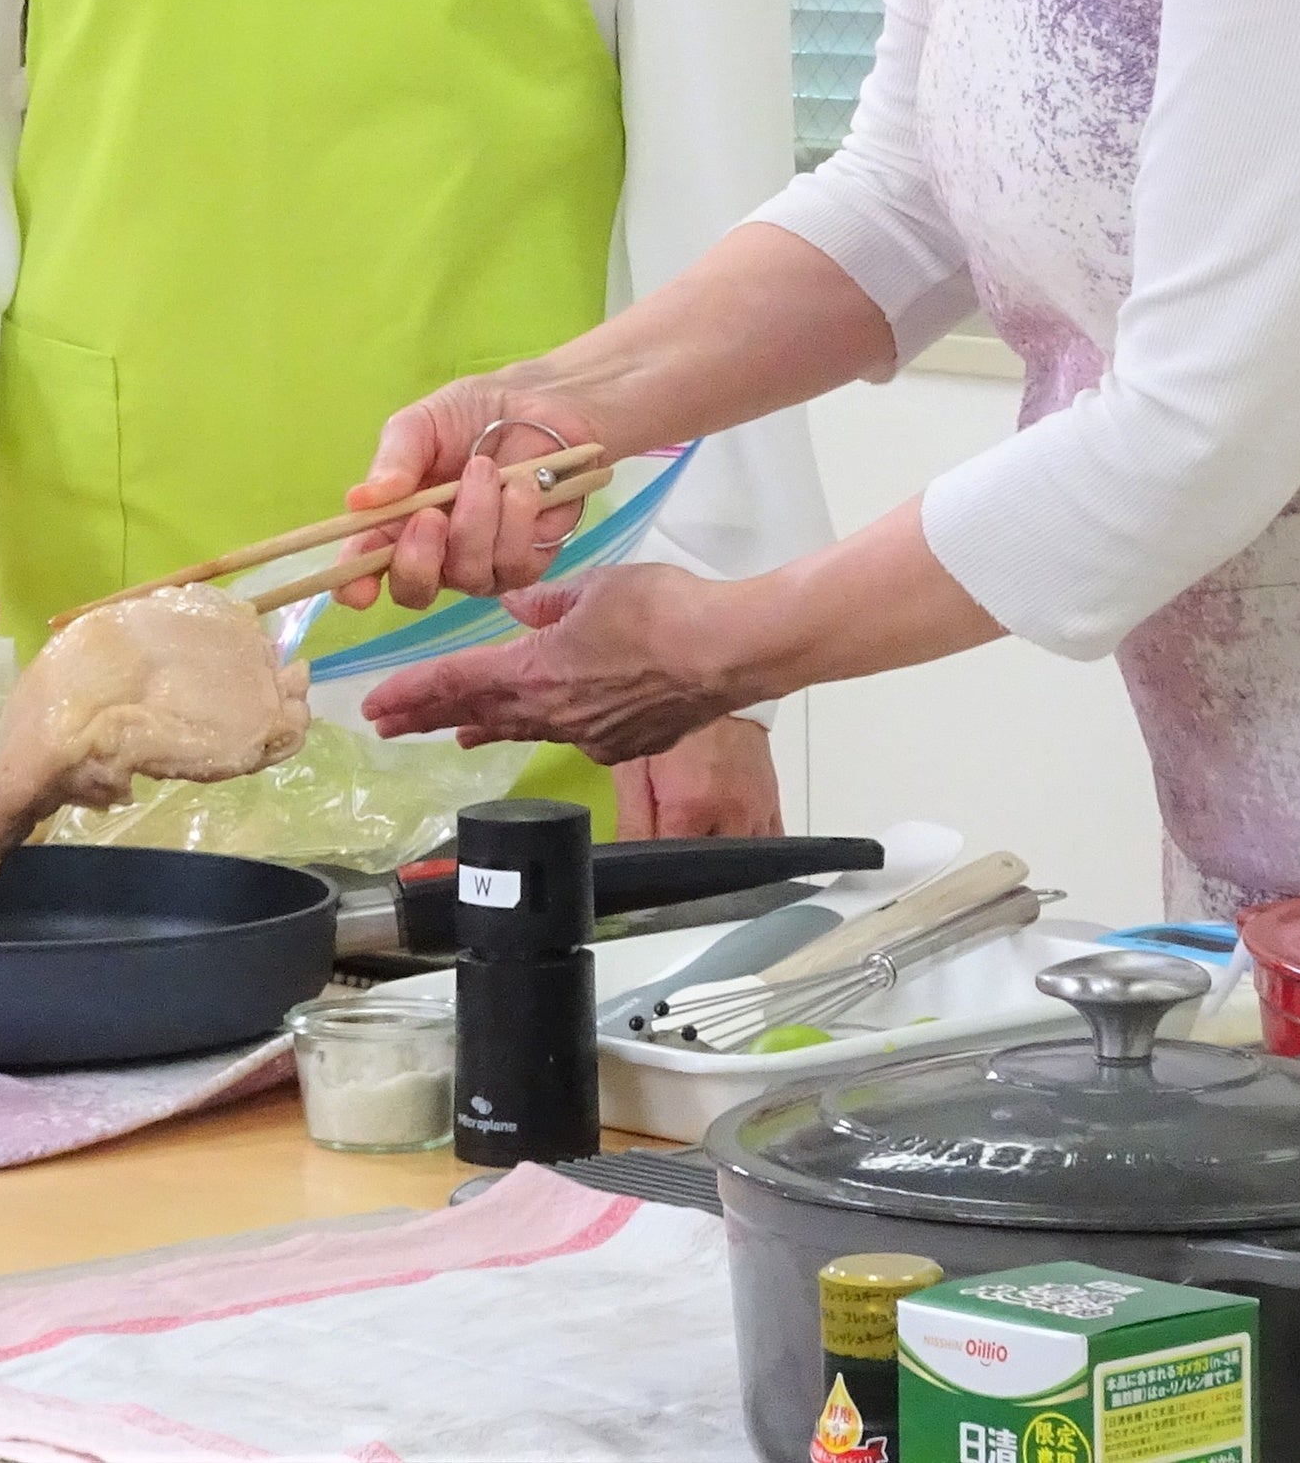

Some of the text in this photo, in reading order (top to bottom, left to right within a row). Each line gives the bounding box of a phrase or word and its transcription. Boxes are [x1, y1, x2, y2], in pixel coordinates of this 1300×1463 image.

[474, 875, 492, 897] W
[965, 1339, 1008, 1363] OilliO
[1034, 1421, 1078, 1452] 限定
